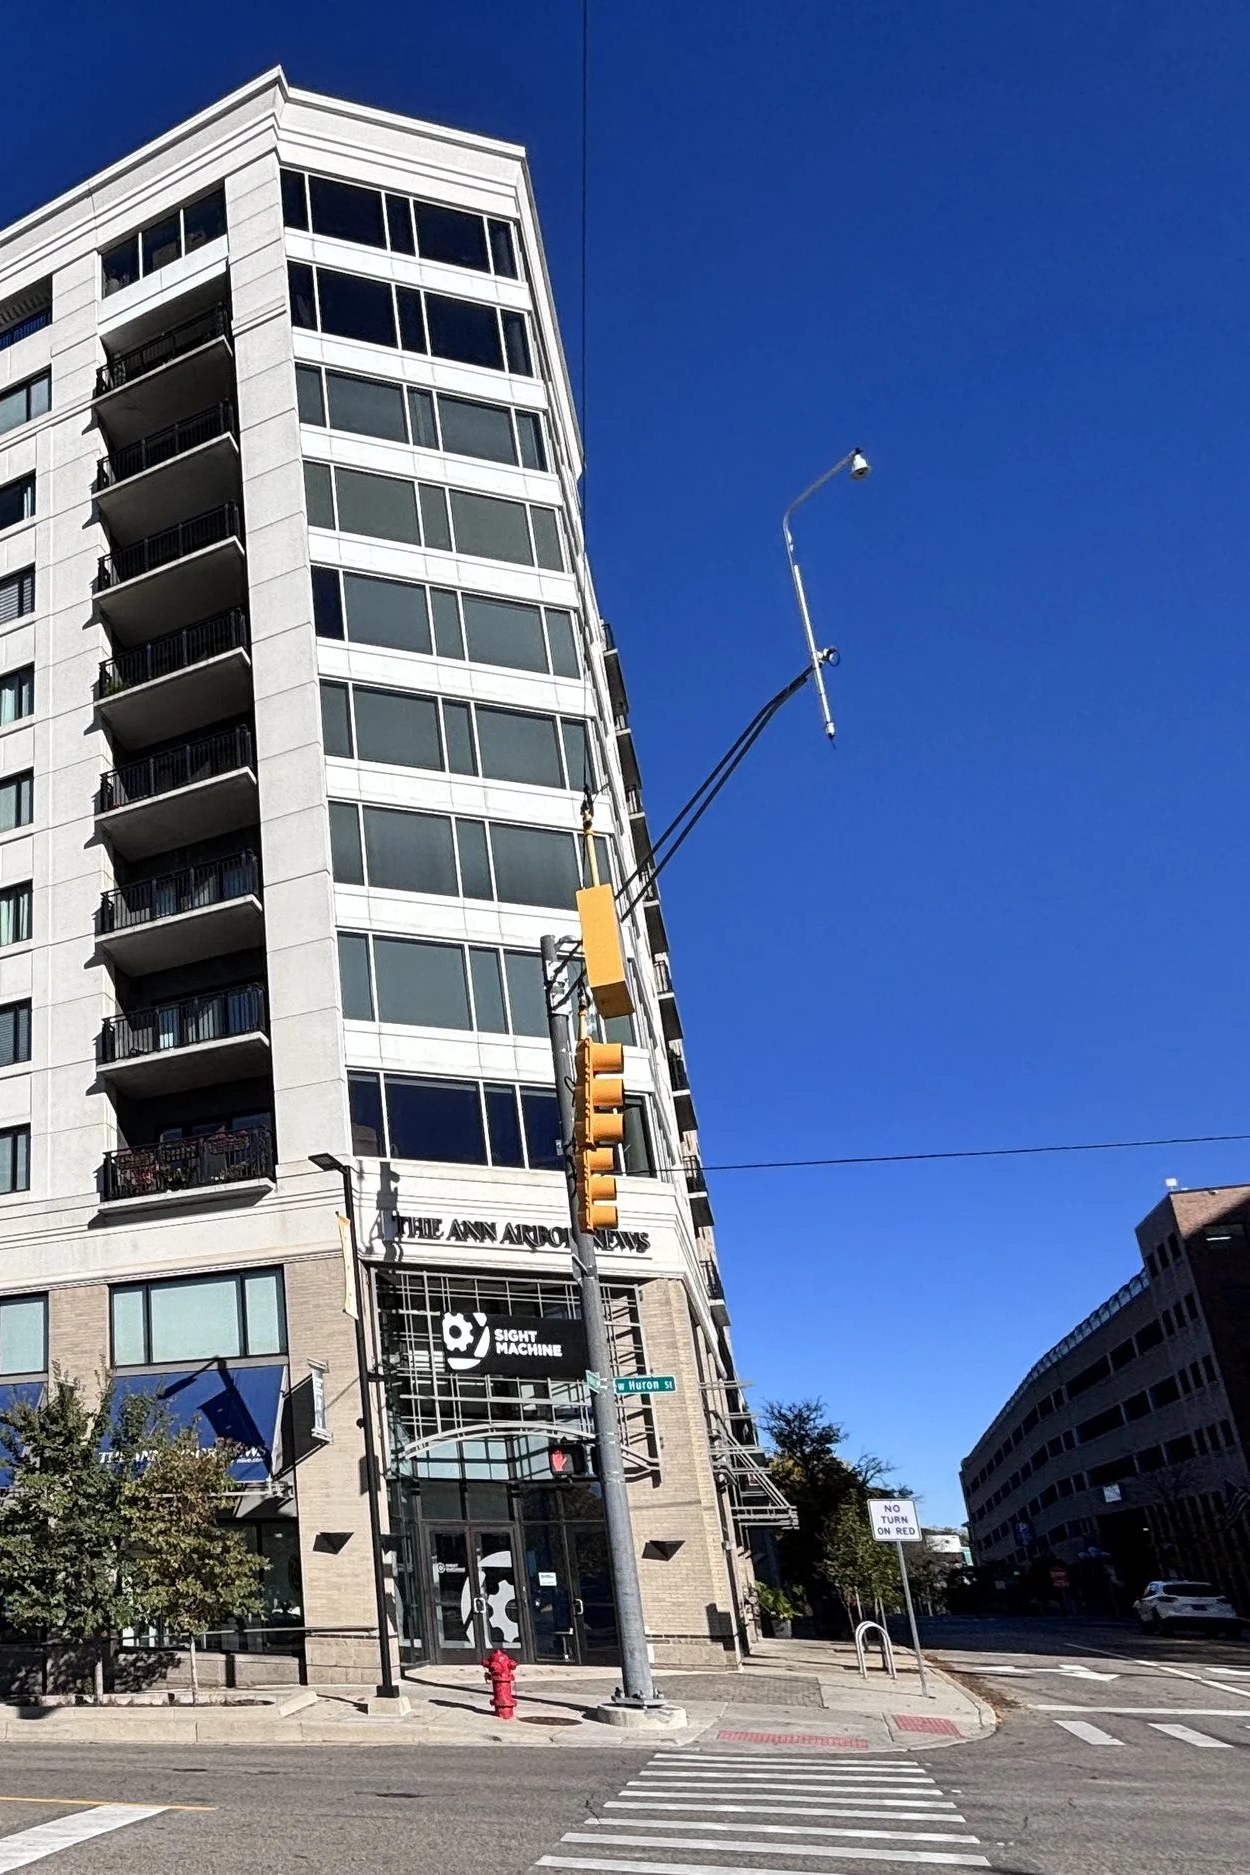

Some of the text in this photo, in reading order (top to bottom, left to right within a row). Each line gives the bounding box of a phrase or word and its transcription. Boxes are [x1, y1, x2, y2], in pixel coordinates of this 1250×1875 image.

[397, 1216, 445, 1240] THE
[446, 1219, 498, 1243] ANN
[494, 1328, 537, 1343] SIGHT
[496, 1342, 563, 1357] MACHINE
[617, 1380, 673, 1391] W Huron St
[884, 1504, 901, 1513] NO
[881, 1515, 908, 1524] TURN
[877, 1527, 915, 1535] ON RED
